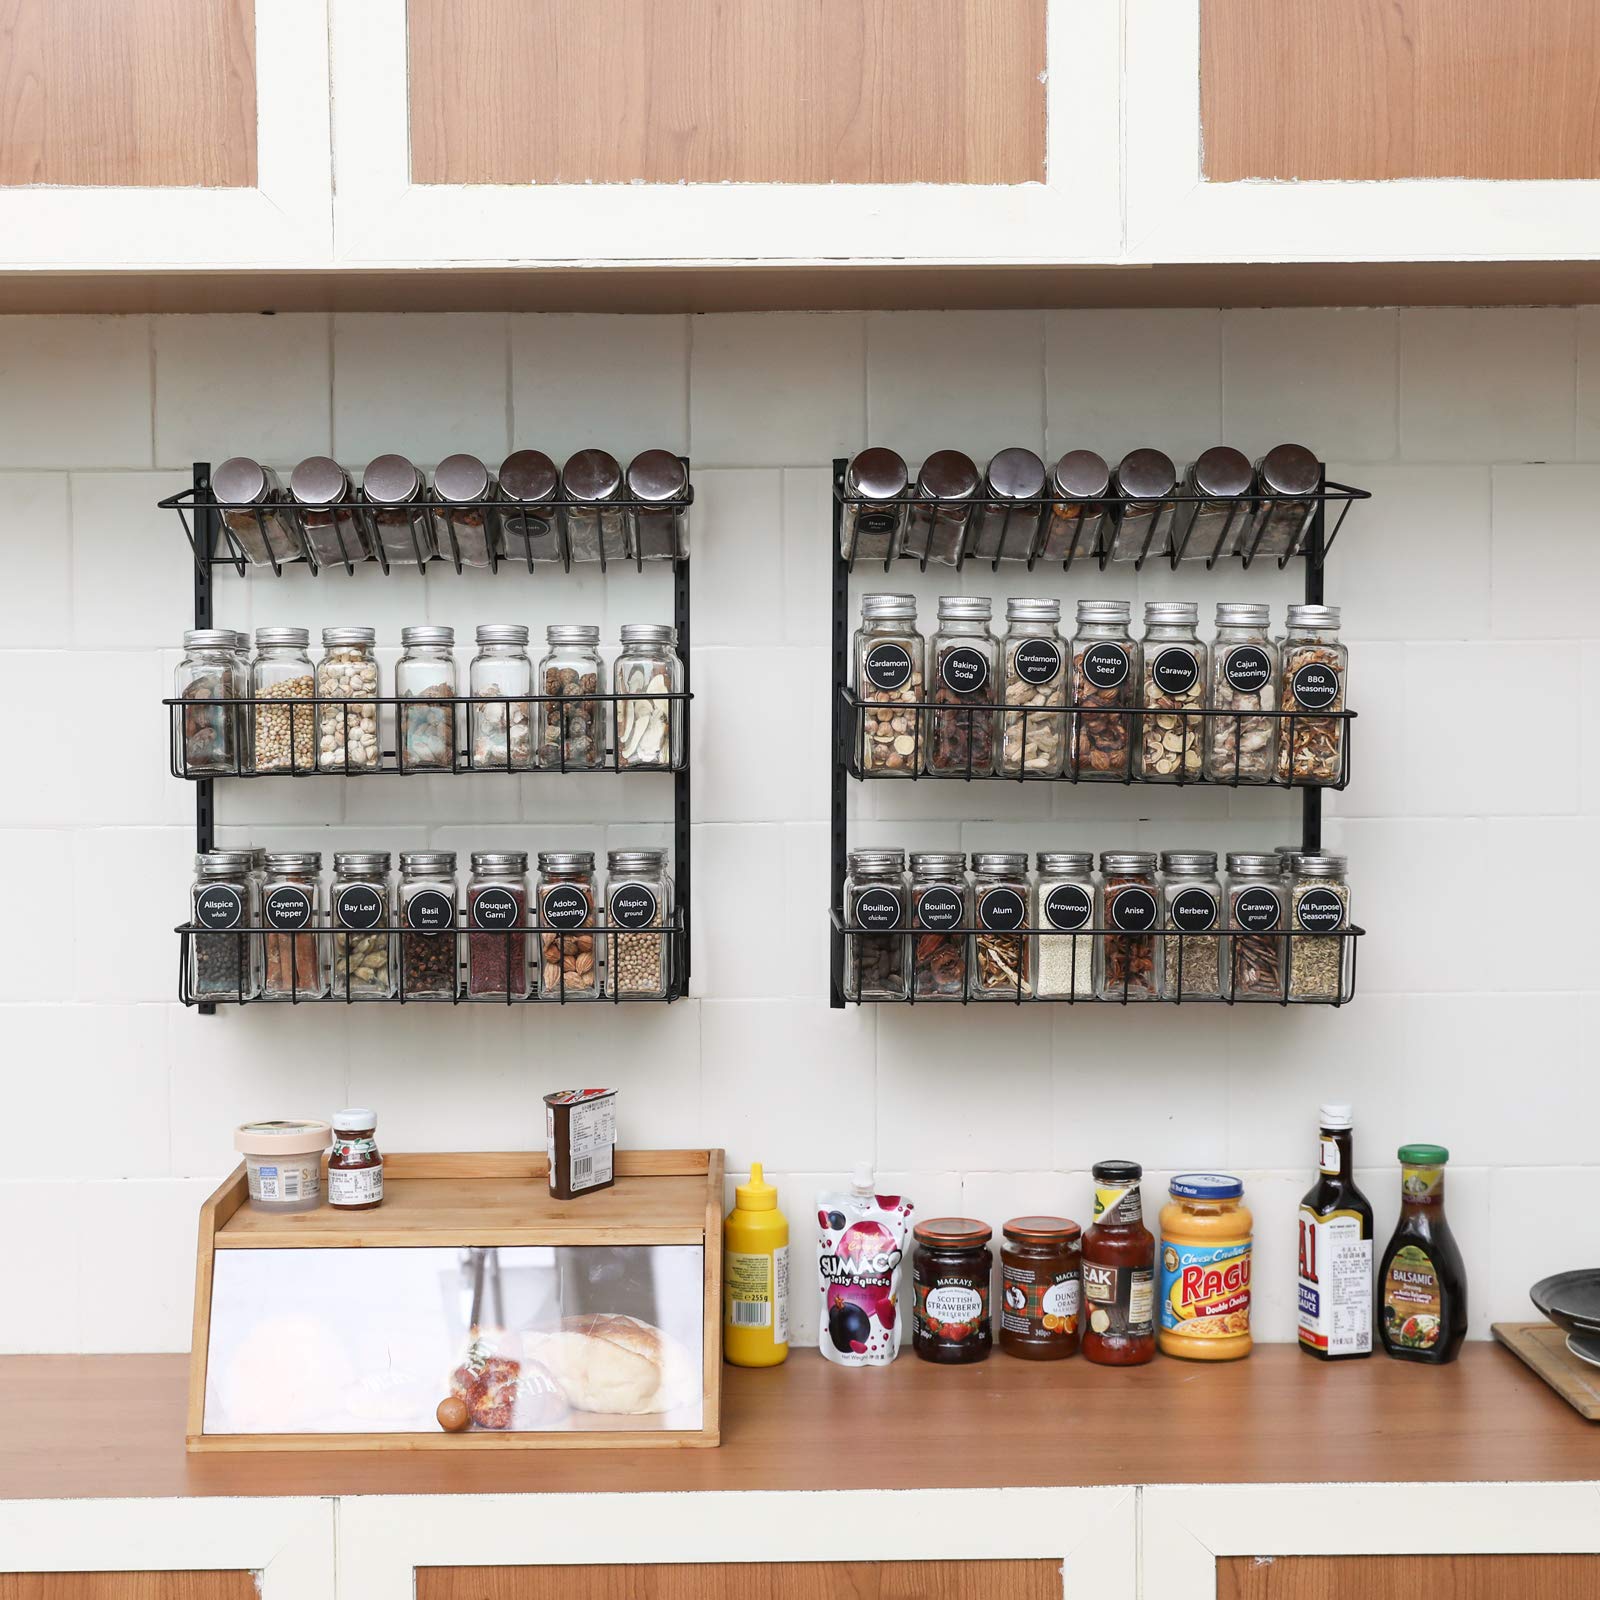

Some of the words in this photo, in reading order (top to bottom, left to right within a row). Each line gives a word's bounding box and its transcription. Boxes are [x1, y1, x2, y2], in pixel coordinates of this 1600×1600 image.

[1018, 654, 1057, 663] Cardamom
[1091, 655, 1122, 666] Annatto
[869, 660, 908, 668] Cardamom
[952, 660, 978, 672] Baking
[1235, 660, 1258, 670] Cajun
[1027, 665, 1047, 673] ground
[1096, 665, 1115, 674] Seed
[1159, 666, 1192, 677] Caraway
[1229, 669, 1267, 678] Seasoning
[954, 670, 974, 680] Soda
[1307, 675, 1325, 683] BBQ
[1296, 684, 1335, 695] Seasoning
[204, 901, 234, 909] Allspice
[270, 900, 304, 909] Cayenne
[344, 903, 358, 913] Bay
[359, 903, 376, 911] Leaf
[479, 901, 512, 910] Bouquet
[552, 900, 577, 908] Adobo
[618, 899, 648, 908] Allspice
[862, 903, 894, 912] Bouillon
[924, 903, 956, 911] Bouillon
[1049, 902, 1088, 913] Arrowroot
[1241, 903, 1274, 912] Caraway
[1300, 903, 1310, 911] All
[1311, 903, 1340, 912] Purpose
[275, 910, 302, 919] Pepper
[421, 907, 439, 915] Basil
[547, 908, 584, 918] Seasoning
[624, 909, 643, 918] ground
[992, 906, 1013, 915] Alum
[1124, 906, 1145, 914] Anise
[1179, 906, 1209, 915] Berbere
[485, 911, 506, 919] Garni
[928, 913, 952, 921] vegetable
[1248, 914, 1267, 922] ground
[1302, 912, 1338, 921] Seasoning
[829, 1274, 851, 1287] Jelly
[852, 1274, 890, 1288] Squeeze
[937, 1277, 973, 1287] MACKAYS
[1393, 1270, 1433, 1286] BALSAMIC
[937, 1295, 973, 1303] SCOTTISH
[927, 1301, 982, 1311] STRAWBERRY
[1205, 1302, 1229, 1315] Double
